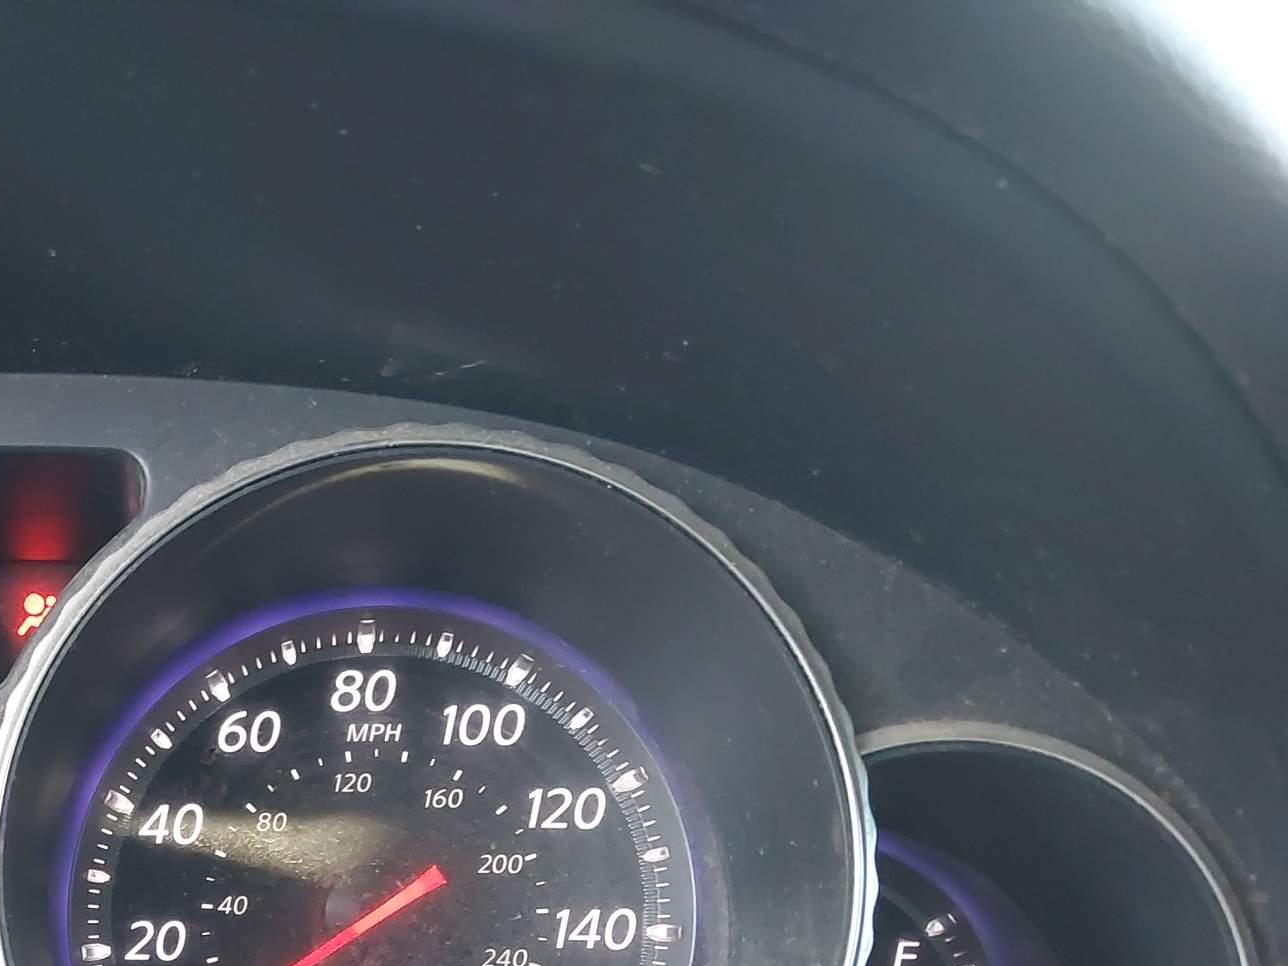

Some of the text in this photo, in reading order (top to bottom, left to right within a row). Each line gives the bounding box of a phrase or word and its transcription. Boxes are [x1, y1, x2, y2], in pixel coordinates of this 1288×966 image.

[330, 669, 397, 712] 80
[217, 710, 282, 753] 60
[346, 723, 402, 743] MPH
[442, 704, 526, 748] 100
[334, 773, 372, 793] 120
[424, 788, 464, 810] 160
[138, 803, 204, 846] 40
[256, 812, 288, 833] 80
[527, 787, 606, 830] 120
[477, 854, 524, 876] 200
[218, 895, 248, 915] 40
[124, 919, 187, 962] 20
[554, 908, 638, 951] 140
